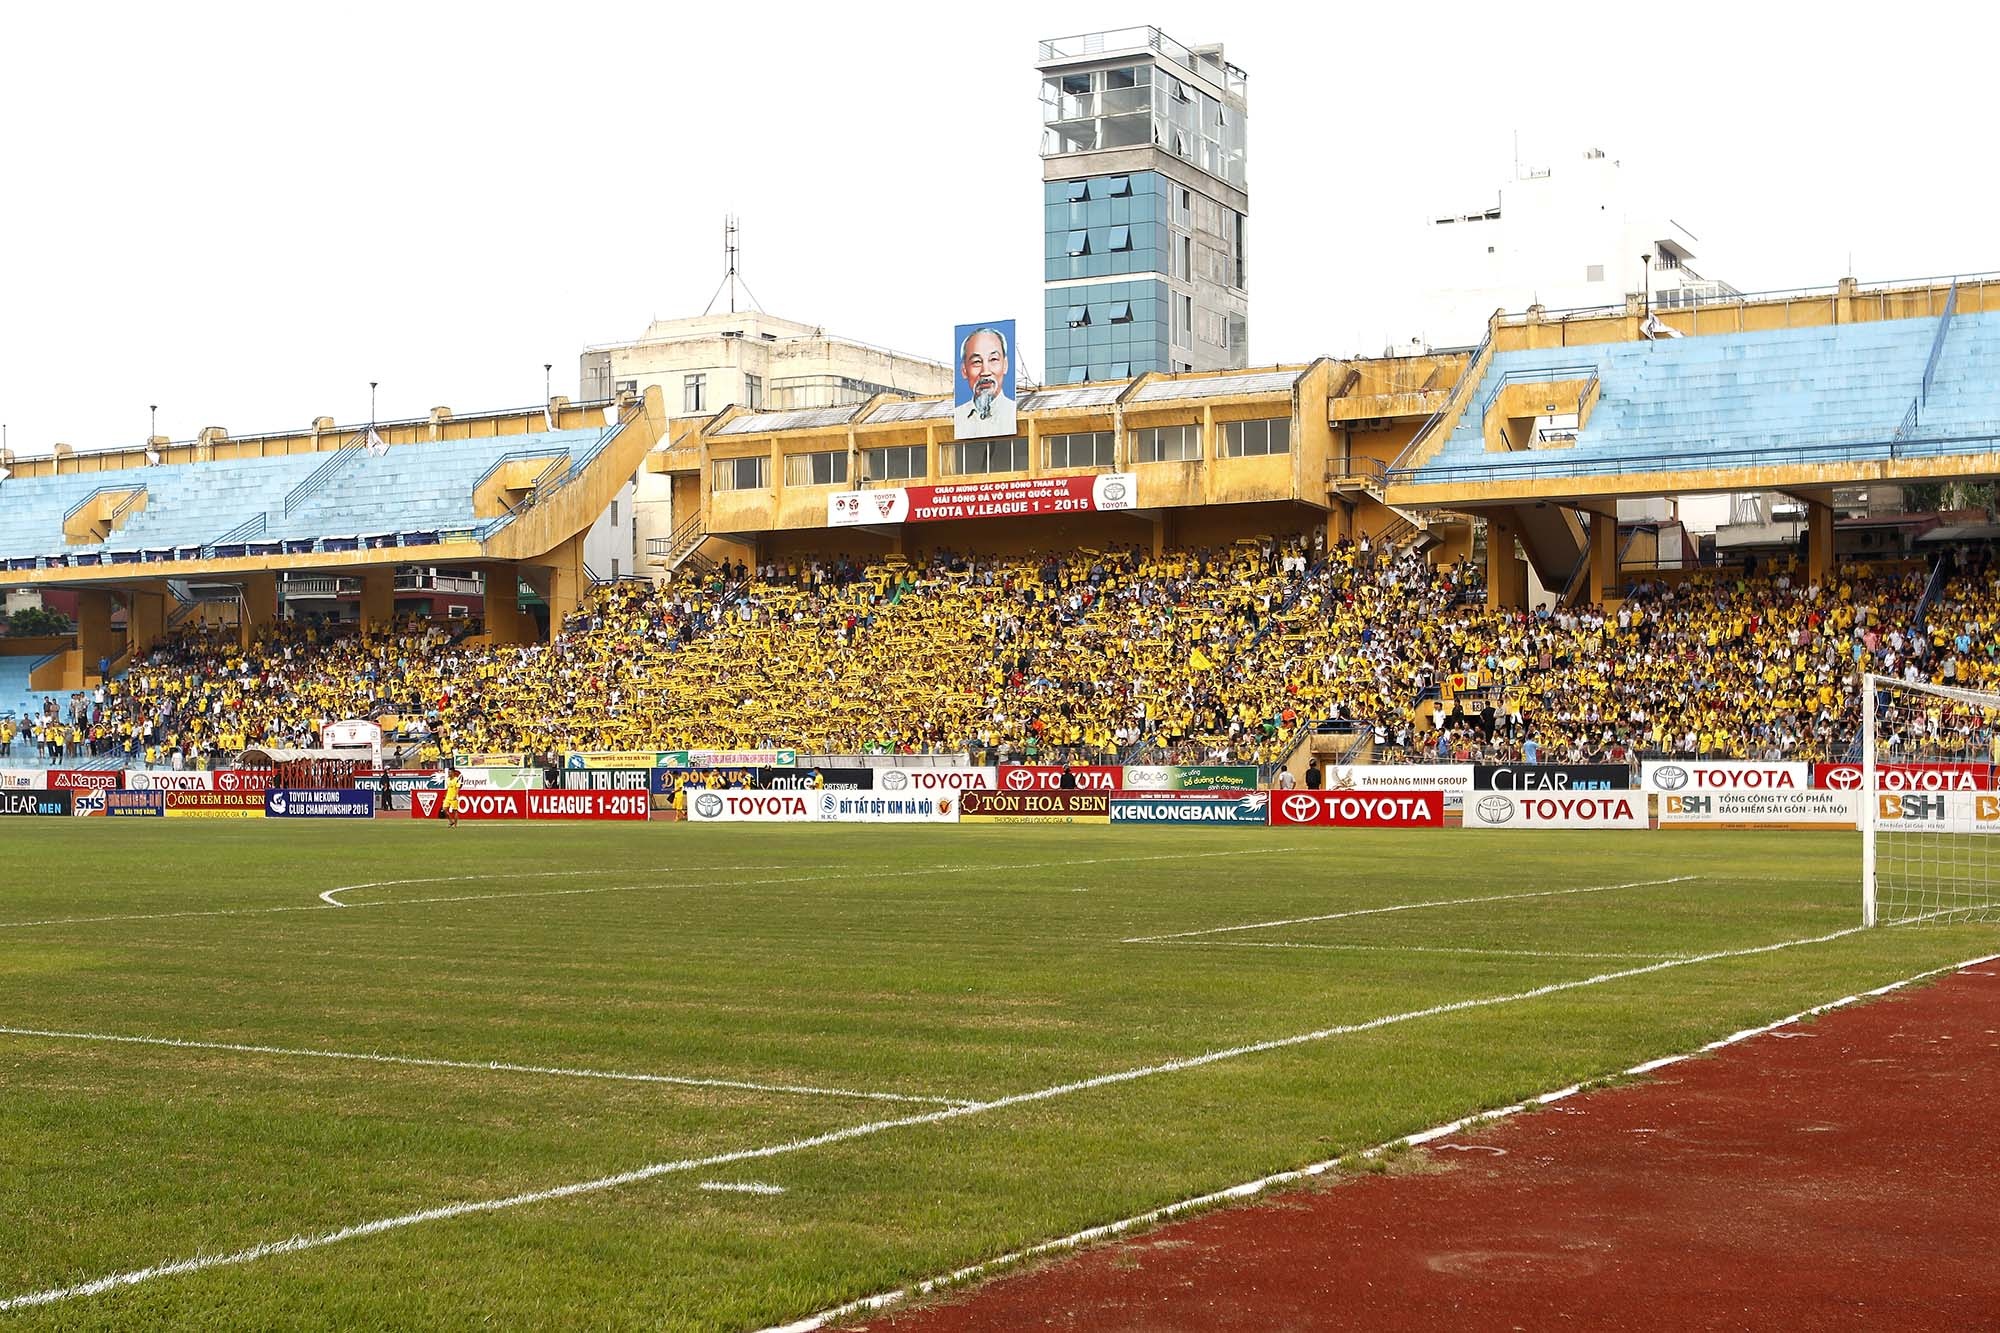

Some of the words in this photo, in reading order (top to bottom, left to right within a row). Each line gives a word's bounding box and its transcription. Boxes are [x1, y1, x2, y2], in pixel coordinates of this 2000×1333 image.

[956, 484, 978, 492] MỪNG
[980, 483, 993, 491] CÁC
[995, 482, 1008, 491] ĐỘI
[1011, 481, 1032, 490] BÓNG
[1033, 480, 1054, 488] THAM
[953, 493, 975, 503] BÓNG
[1005, 490, 1026, 500] ĐỊCH
[1028, 488, 1052, 499] QUỐC
[1054, 488, 1070, 497] GIA
[914, 506, 963, 519] TOYOTA
[966, 501, 1028, 517] V.LEAGUE
[1032, 502, 1040, 512] 1
[1054, 499, 1089, 511] 2015
[1101, 501, 1128, 509] TOYOTA
[1473, 702, 1481, 712] 13
[17, 778, 30, 786] AGRI
[72, 776, 116, 788] Kappa
[152, 776, 206, 789] TOYOTA
[355, 780, 429, 791] KIENLNGBANK
[565, 771, 589, 790] MINH
[591, 771, 612, 790] TIEN
[613, 771, 647, 790] COFFEE
[772, 773, 813, 790] mitre
[911, 773, 987, 789] TOYOTA
[1037, 772, 1115, 790] TOOTA
[1183, 776, 1193, 787] bổ
[1194, 776, 1214, 785] dưỡng
[1215, 775, 1244, 785] Collagen
[1362, 775, 1378, 785] TÂN
[1380, 774, 1411, 785] HOÀNG
[1413, 777, 1436, 785] MINH
[1437, 777, 1468, 785] GROUP
[1491, 768, 1568, 791] CLEAR
[1573, 780, 1611, 790] MEN
[1693, 770, 1795, 788] TOYOTA
[1875, 770, 1978, 791] TOYOTA
[75, 797, 105, 809] SHS
[224, 795, 244, 805] HOA
[246, 795, 265, 805] SEN
[289, 791, 313, 802] TOYOTA
[314, 791, 340, 802] MEKONG
[449, 795, 518, 814] OYOTA
[983, 791, 1019, 811] TÔN
[1024, 796, 1064, 811] HOA
[1069, 796, 1108, 811] SEN
[1718, 793, 1745, 803] TỔNG
[1747, 793, 1775, 803] CÔNG
[1775, 795, 1788, 803] TY
[1791, 793, 1803, 803] CỔ
[39, 804, 62, 814] MEN
[289, 804, 305, 815] CLUB
[306, 804, 351, 815] CHAMPIONSHIP
[353, 804, 369, 815] 2015
[529, 796, 592, 814] V.LEAGUE
[597, 796, 646, 814] 1-2015
[727, 797, 807, 815] TOYOTA
[840, 797, 852, 814] BÍT
[855, 795, 868, 814] TẤT
[871, 798, 886, 817] DỆT
[888, 800, 903, 814] KIM
[905, 797, 917, 814] HÀ
[919, 798, 933, 817] NỘI
[1111, 805, 1239, 821] KIENLONGBANK
[1324, 799, 1432, 820] TOYOTA
[1520, 799, 1634, 820] TOYOTA
[1666, 796, 1712, 814] BSH
[1719, 804, 1738, 814] BẢO
[1741, 803, 1765, 814] HIỂM
[1767, 804, 1782, 814] SÀI
[1784, 804, 1806, 814] GÒN
[1813, 804, 1827, 814] HÀ
[1830, 804, 1847, 815] NỘI
[1879, 794, 1945, 820] BSH
